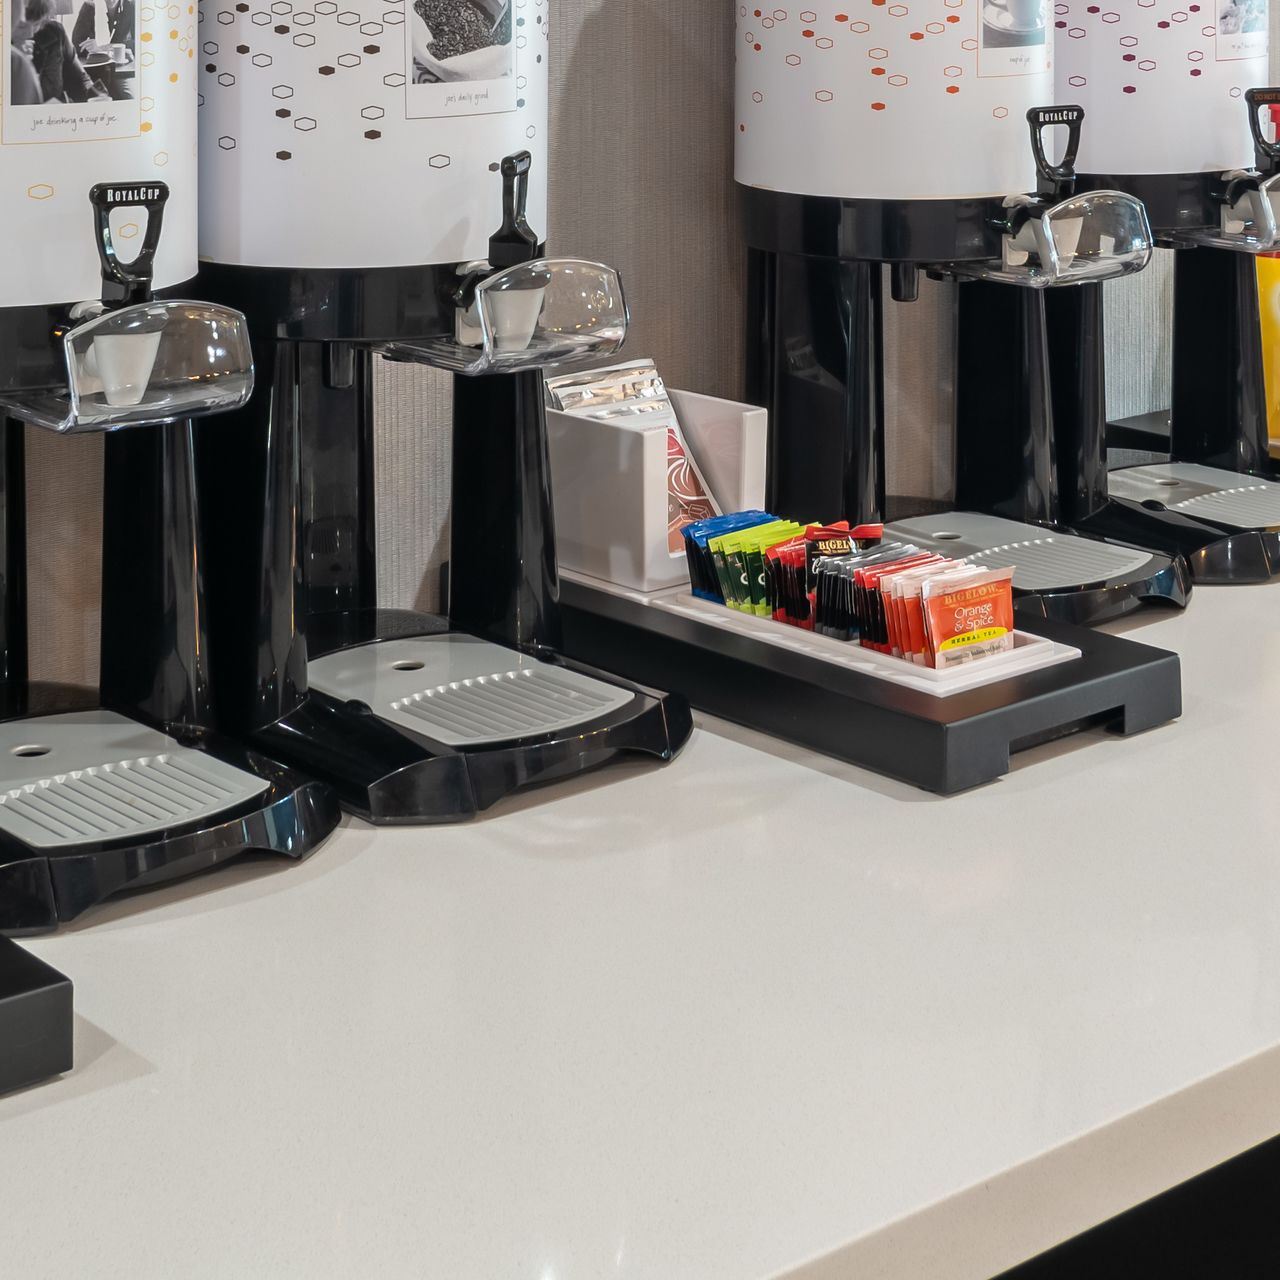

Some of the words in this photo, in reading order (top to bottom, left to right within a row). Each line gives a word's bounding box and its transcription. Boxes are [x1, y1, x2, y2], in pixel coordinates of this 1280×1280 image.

[954, 602, 992, 619] Orange
[954, 620, 964, 633] &
[965, 615, 994, 635] Spice
